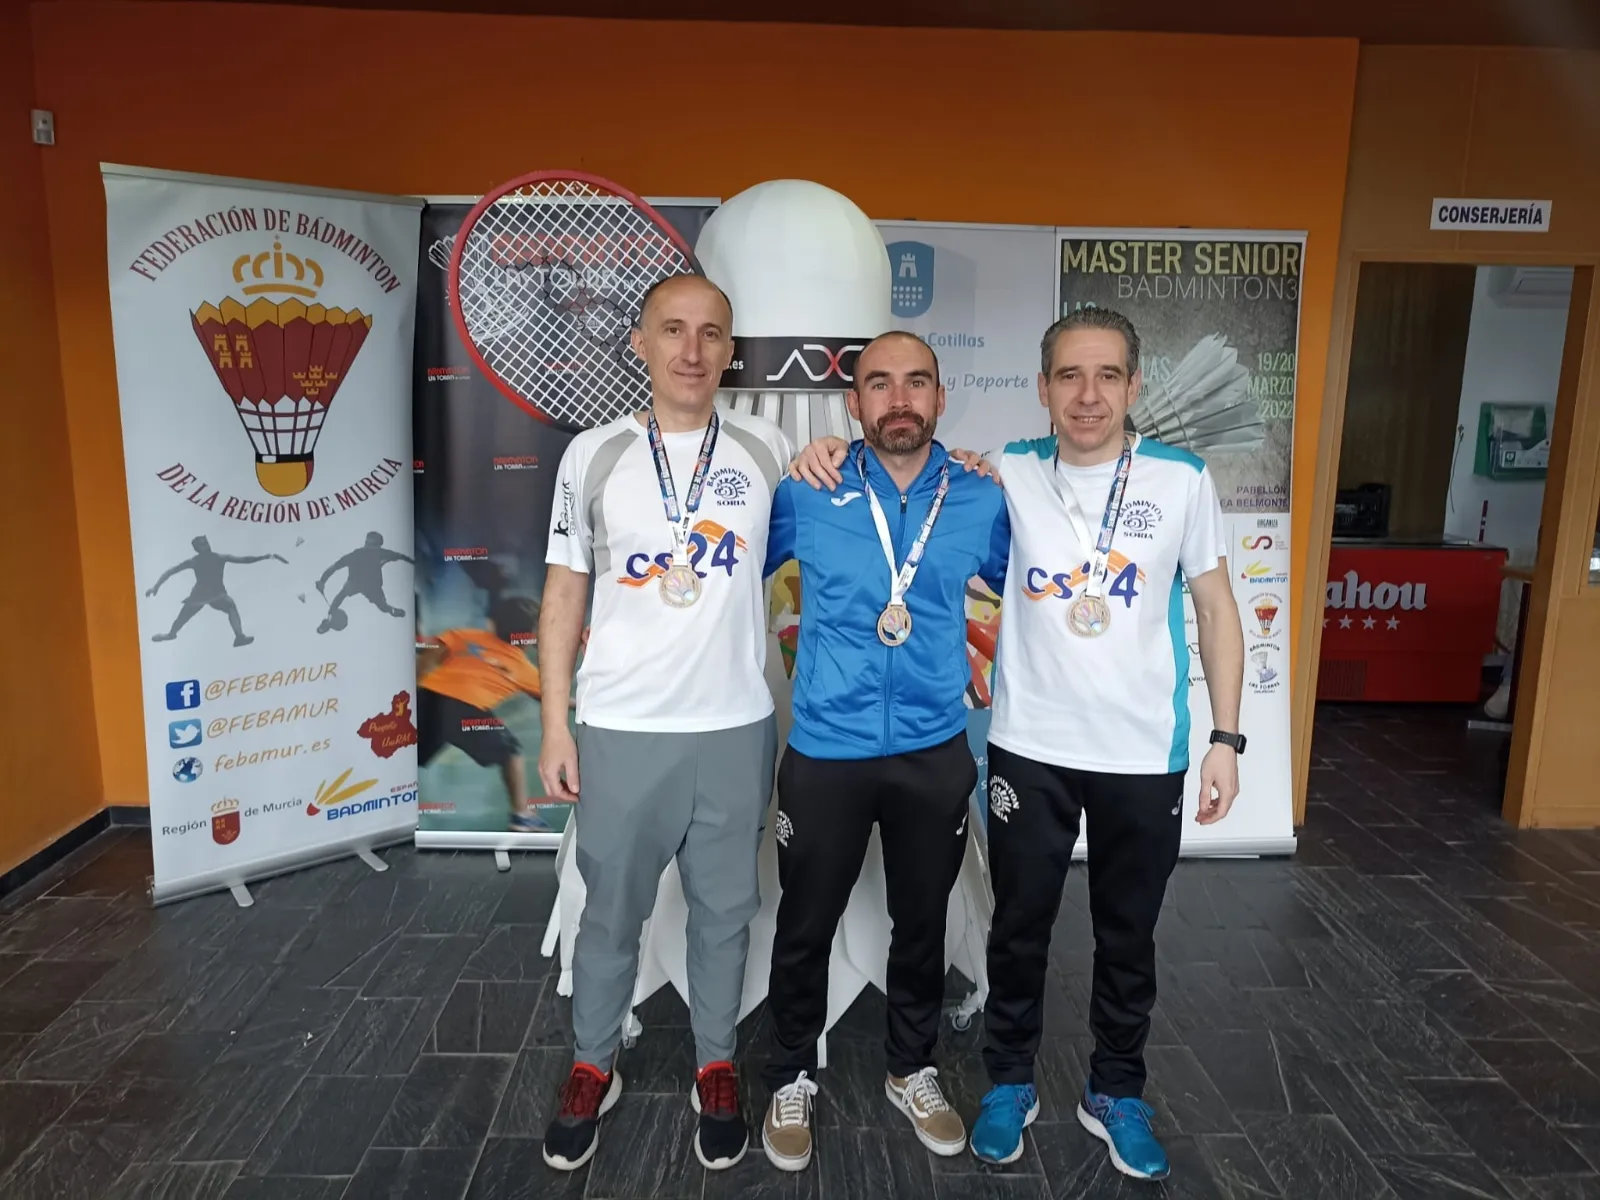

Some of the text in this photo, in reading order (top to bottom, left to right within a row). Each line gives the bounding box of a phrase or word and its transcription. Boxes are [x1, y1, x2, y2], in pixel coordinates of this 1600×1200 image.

[1438, 203, 1543, 225] CONSERJERÍA
[129, 205, 402, 295] FEDERACIÓN DE BÁDMINTON
[1063, 241, 1299, 277] MASTER SENIOR
[1258, 352, 1295, 371] 19/20
[946, 373, 1029, 393] y Deporte
[1247, 376, 1294, 396] MARZO
[1260, 400, 1293, 418] 2022
[707, 467, 752, 487] BADMINTON
[156, 462, 197, 494] DE
[186, 484, 220, 512] LA
[220, 495, 302, 524] REGIÓN
[307, 496, 336, 521] DE
[334, 457, 403, 511] MURCIA
[1119, 500, 1163, 521] BADMINTON
[1236, 498, 1288, 509] BELMONTE
[1123, 532, 1153, 540] SORIA
[1027, 563, 1139, 609] CS4
[205, 662, 338, 701] @FEBAMUR
[207, 698, 339, 739] @FEBAMUR
[214, 736, 332, 773] febamur.es
[161, 797, 303, 837] Región de Murcia
